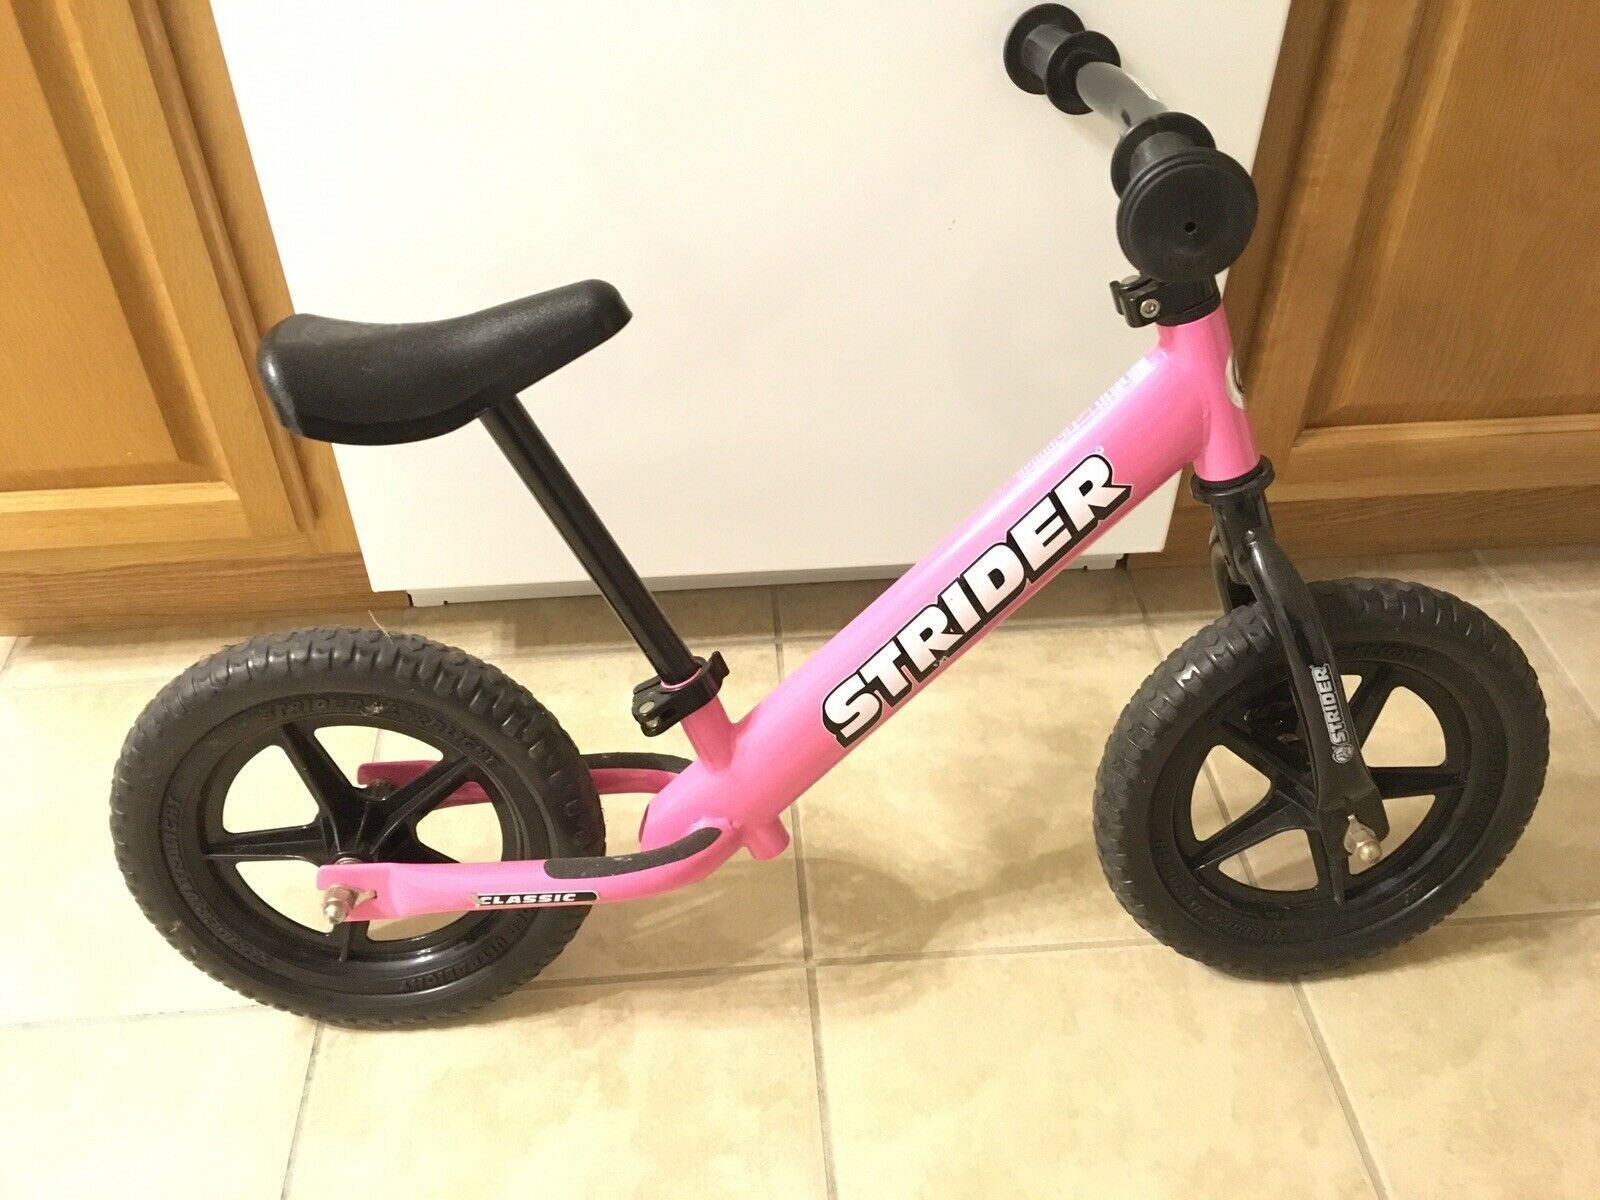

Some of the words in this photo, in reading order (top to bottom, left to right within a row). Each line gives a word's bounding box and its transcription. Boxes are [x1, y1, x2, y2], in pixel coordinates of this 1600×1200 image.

[823, 454, 1132, 746] STRIDER
[1312, 666, 1348, 746] STRIDER
[479, 893, 577, 905] CLASSIC
